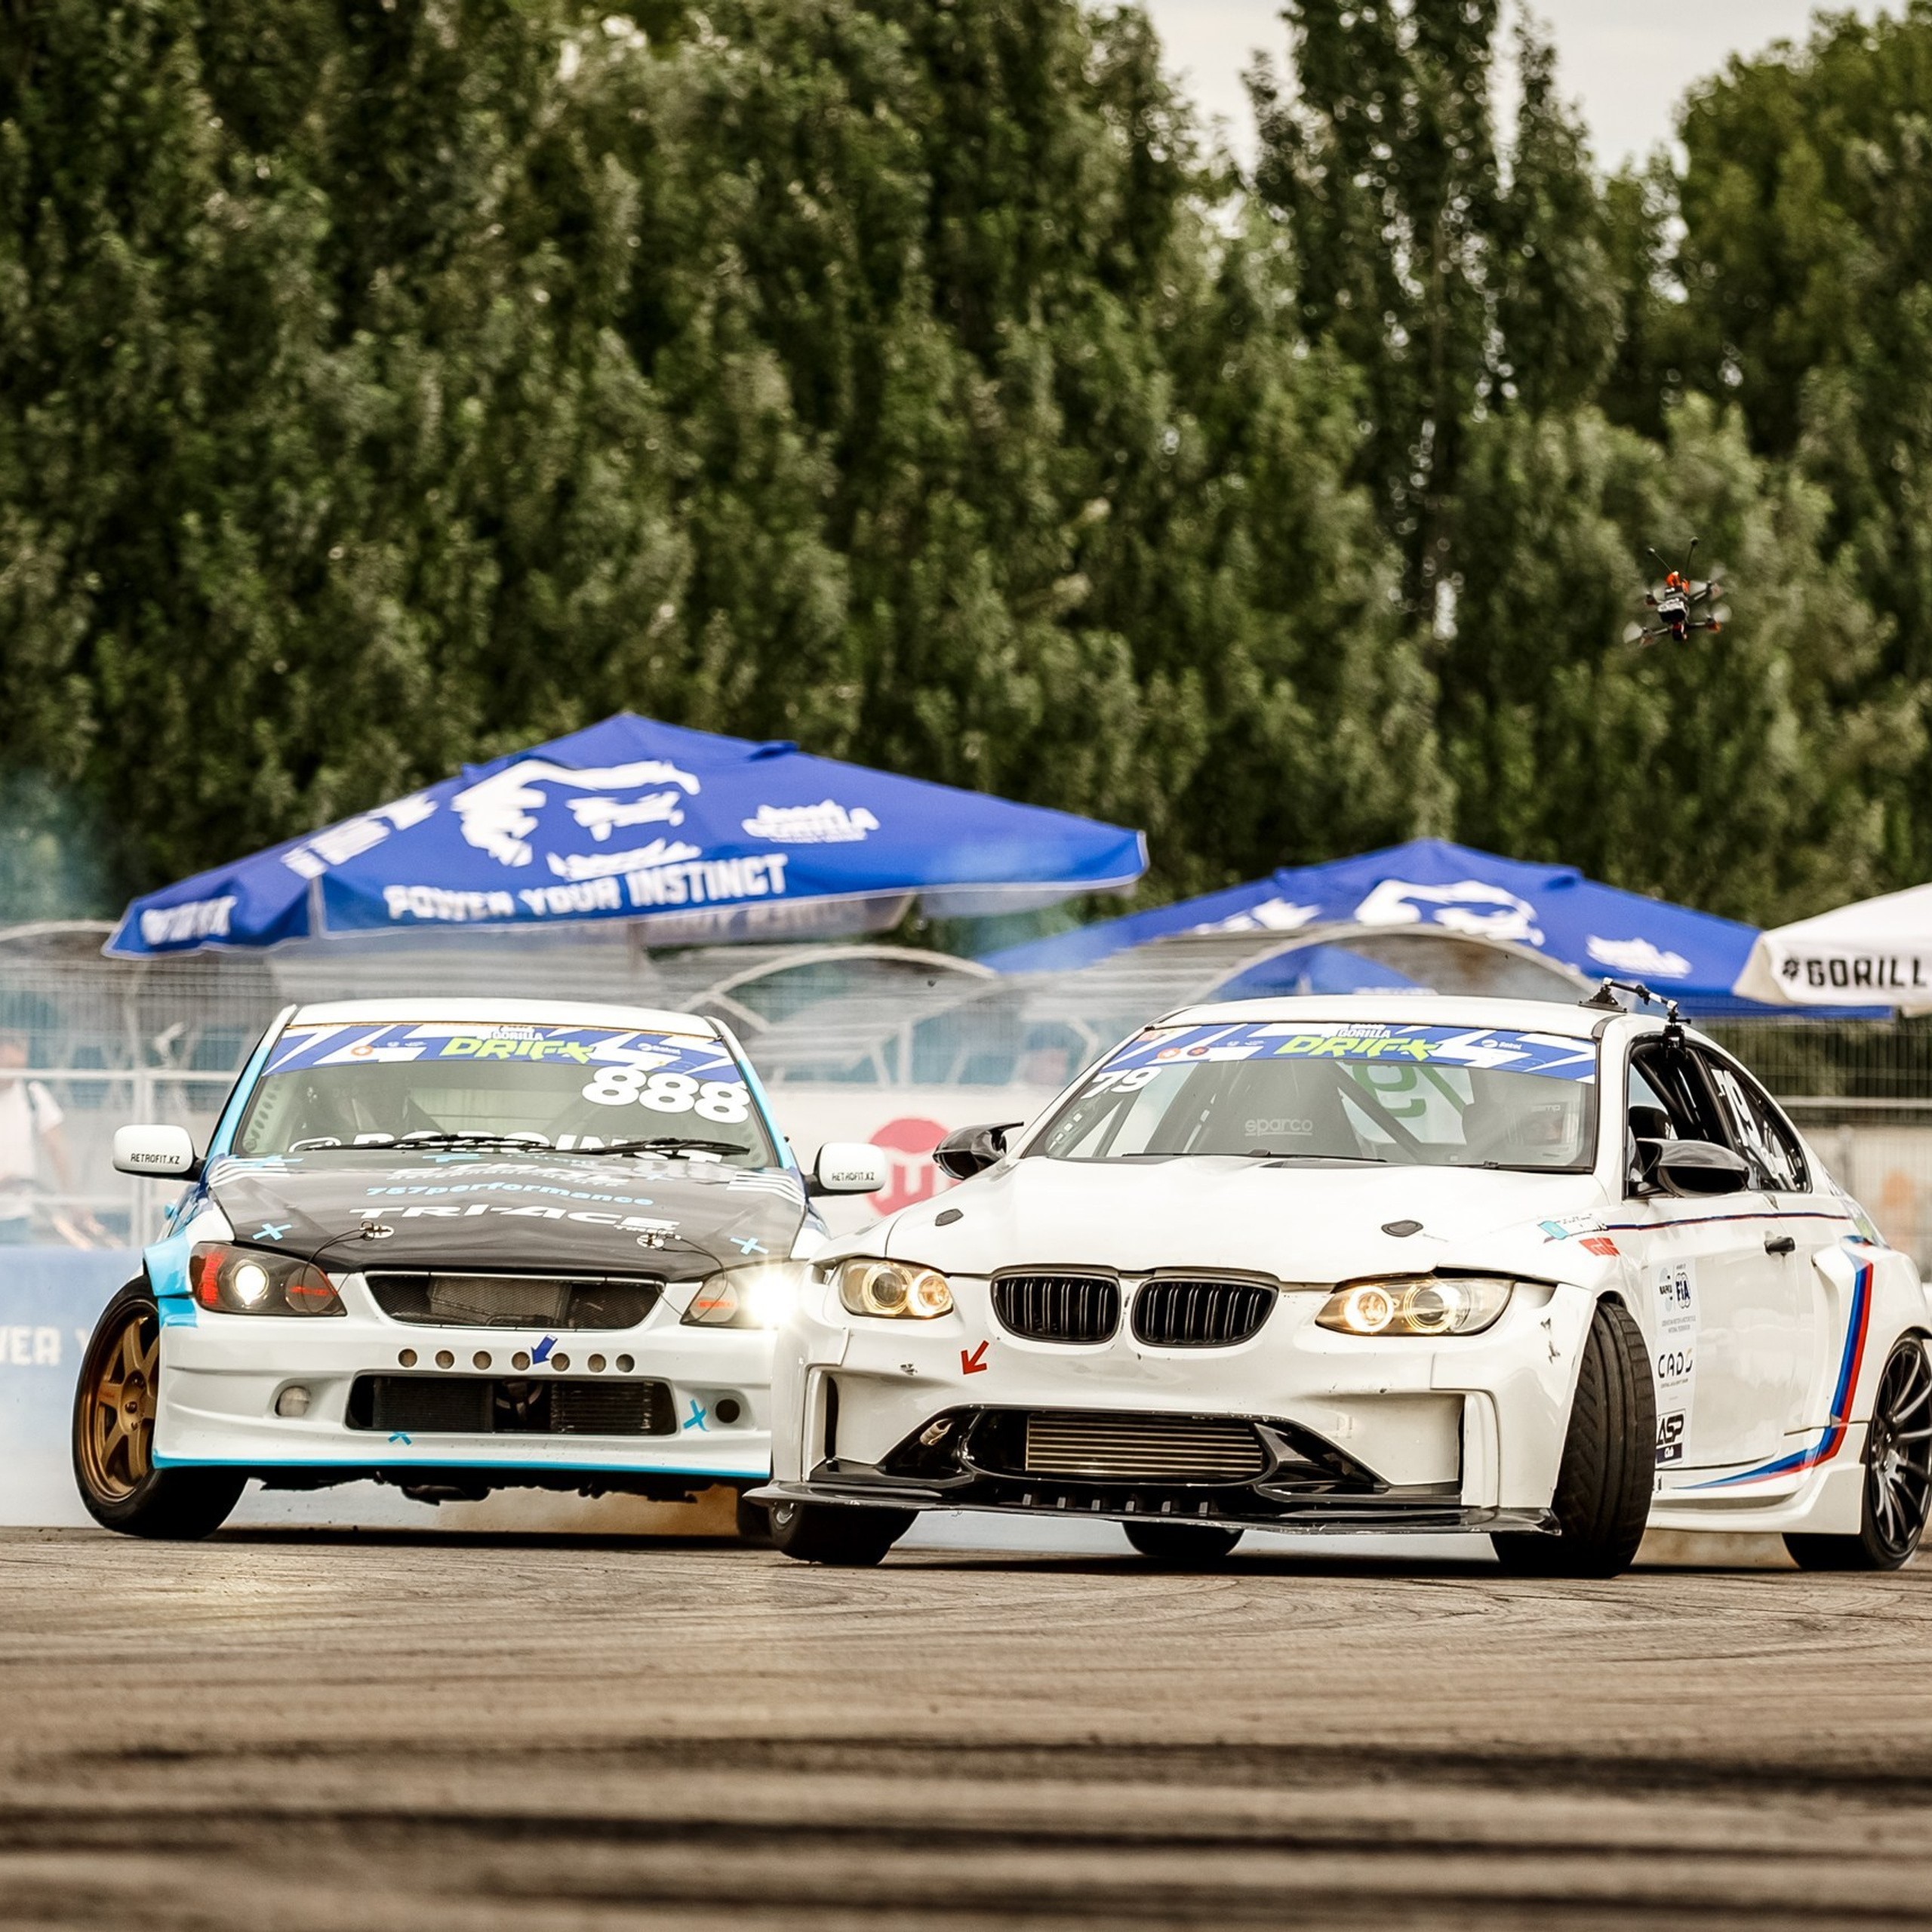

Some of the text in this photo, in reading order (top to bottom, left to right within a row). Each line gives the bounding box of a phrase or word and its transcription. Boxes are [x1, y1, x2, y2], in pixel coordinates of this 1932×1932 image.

[383, 884, 515, 921] POWER
[518, 876, 621, 915] YOUR
[626, 853, 788, 906] INSTINCT
[1337, 1028, 1391, 1038] GORILLA
[1080, 1066, 1162, 1100] 79
[582, 1066, 750, 1124] 888
[1245, 1118, 1313, 1137] sparco
[131, 1152, 180, 1164] RETROFIT.KZ
[832, 1172, 875, 1181] RETROFIT.KZ
[349, 1204, 680, 1230] TRI-ACE
[1675, 1280, 1691, 1301] FIA
